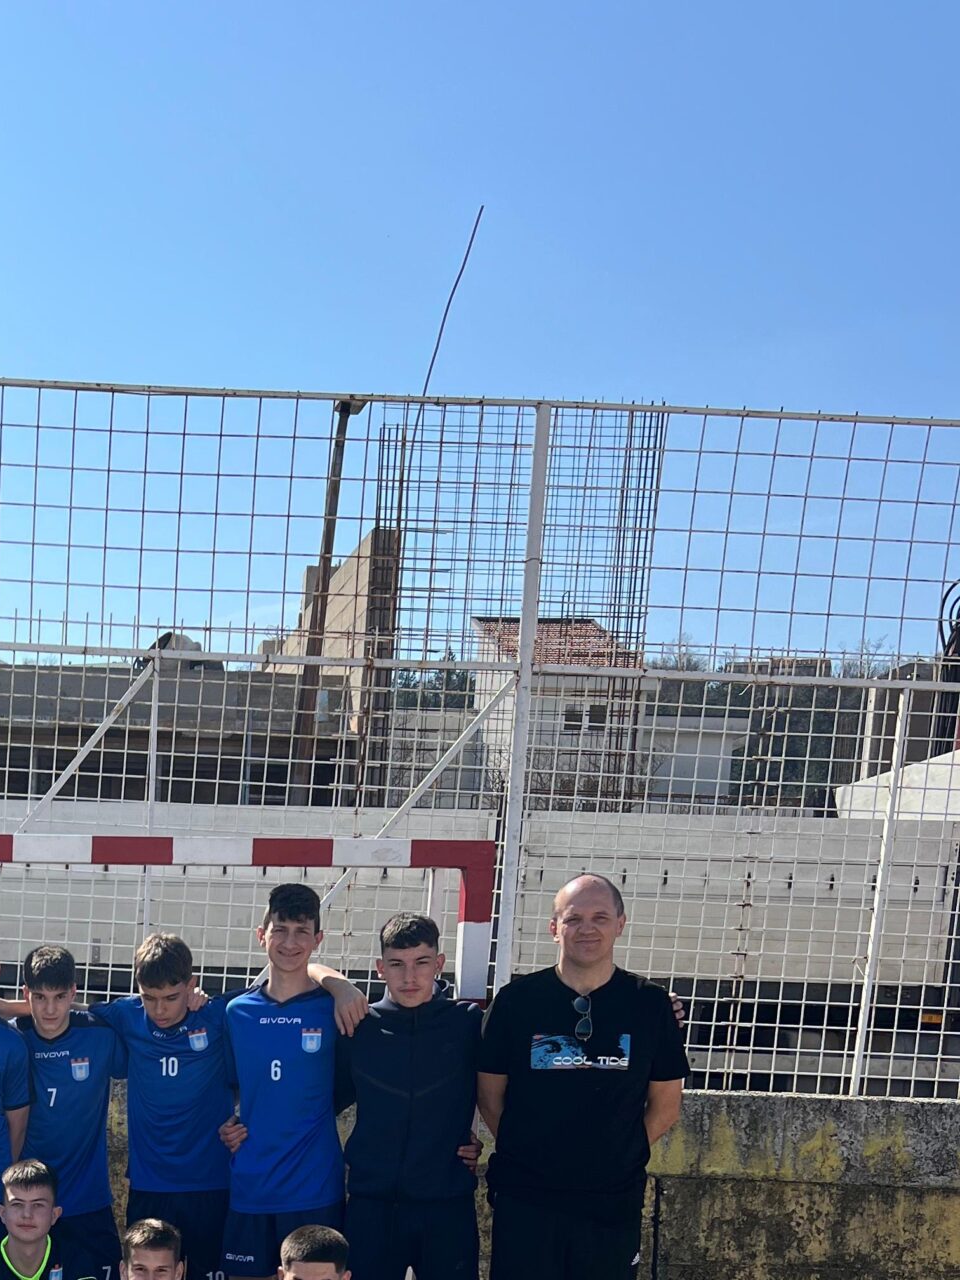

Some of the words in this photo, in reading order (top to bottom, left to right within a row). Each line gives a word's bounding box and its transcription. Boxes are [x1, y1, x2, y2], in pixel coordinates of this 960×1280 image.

[159, 1057, 179, 1077] 10
[270, 1060, 282, 1081] 6
[552, 1056, 592, 1065] COOL
[597, 1056, 629, 1067] TIDE
[47, 1088, 57, 1107] 7
